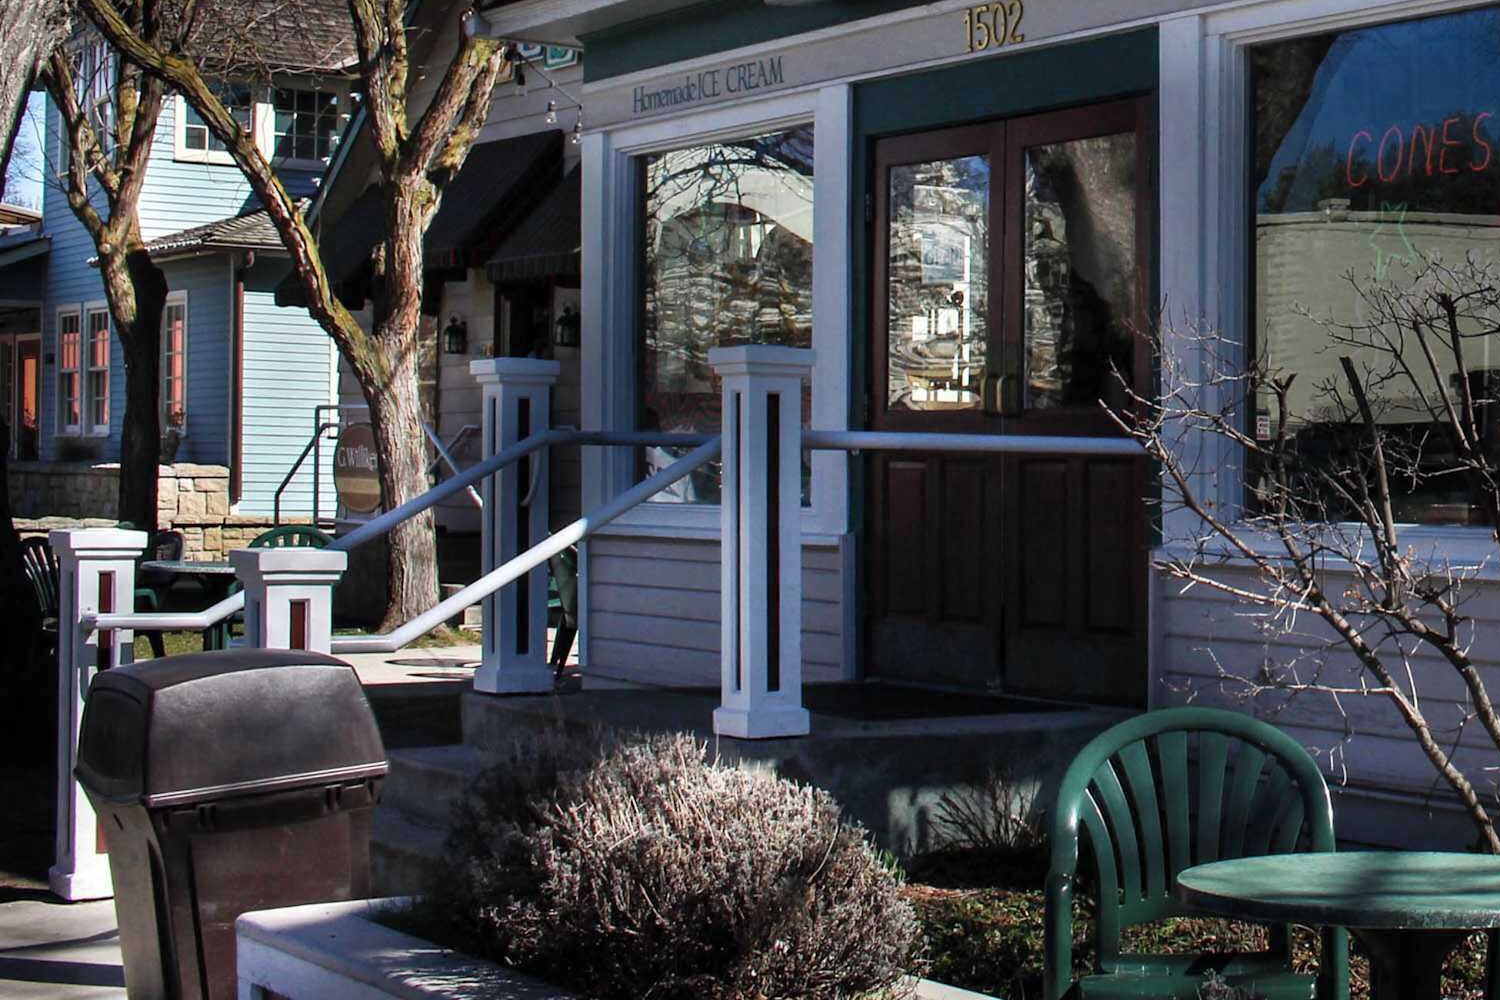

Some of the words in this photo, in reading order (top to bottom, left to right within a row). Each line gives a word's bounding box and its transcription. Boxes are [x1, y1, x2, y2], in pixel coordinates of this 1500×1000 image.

[632, 76, 696, 113] Homemade
[698, 69, 721, 99] ICE
[725, 56, 784, 93] CREAM
[1346, 112, 1494, 187] CONES
